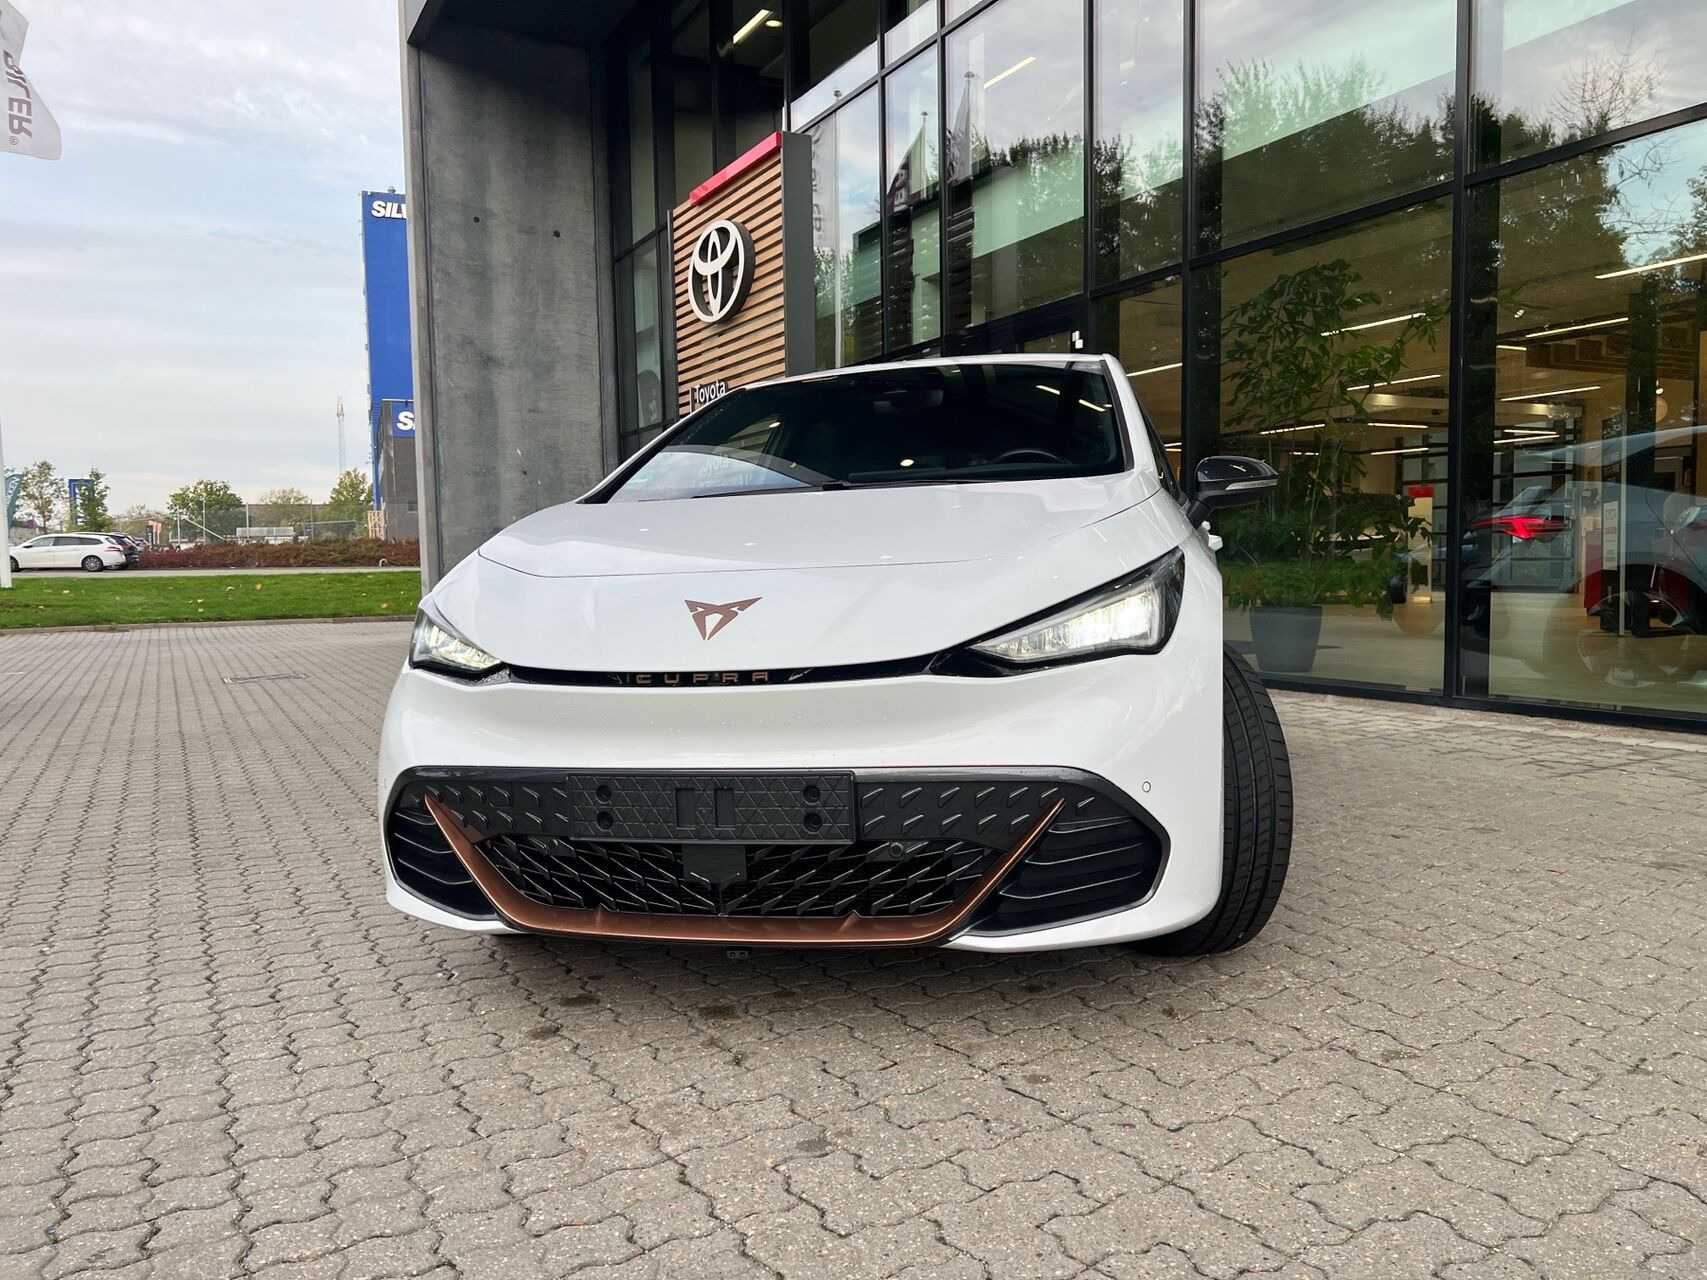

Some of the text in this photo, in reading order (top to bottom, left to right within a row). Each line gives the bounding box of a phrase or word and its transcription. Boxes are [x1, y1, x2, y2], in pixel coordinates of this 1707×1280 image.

[694, 379, 726, 405] Toyota
[396, 410, 416, 431] S
[635, 671, 769, 684] CUPRA
